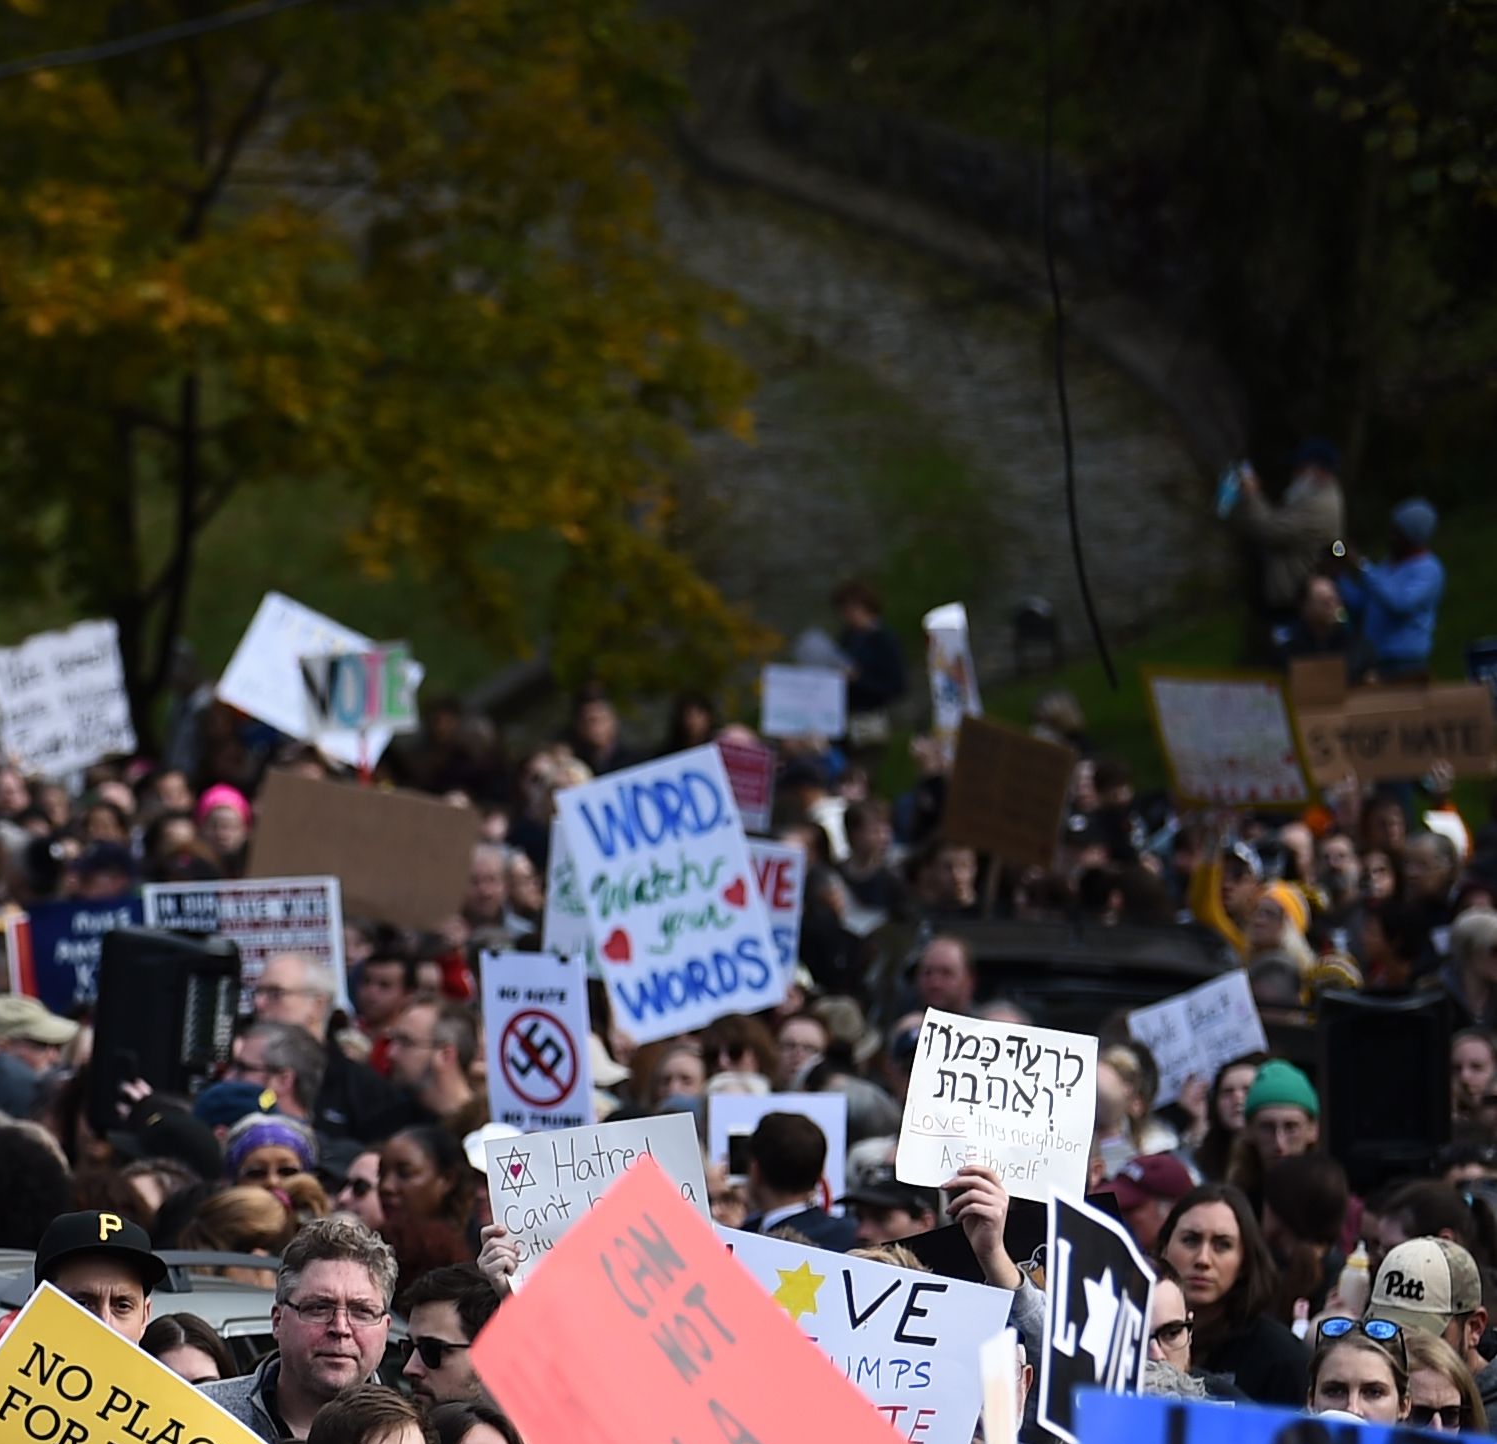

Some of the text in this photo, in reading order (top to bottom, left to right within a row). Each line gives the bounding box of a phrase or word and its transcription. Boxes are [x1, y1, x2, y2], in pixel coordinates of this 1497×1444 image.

[497, 986, 567, 1005] NO HATE
[617, 937, 771, 1023] WORDS
[909, 1108, 1082, 1155] Love thy neighbor
[553, 1137, 655, 1188] Hatred
[98, 1212, 122, 1241] P
[504, 1182, 695, 1237] Can't a
[515, 1236, 555, 1266] City
[599, 1209, 686, 1317] CAN
[1383, 1271, 1426, 1302] Pitt
[650, 1282, 737, 1387] NOT
[18, 1341, 93, 1404] NO
